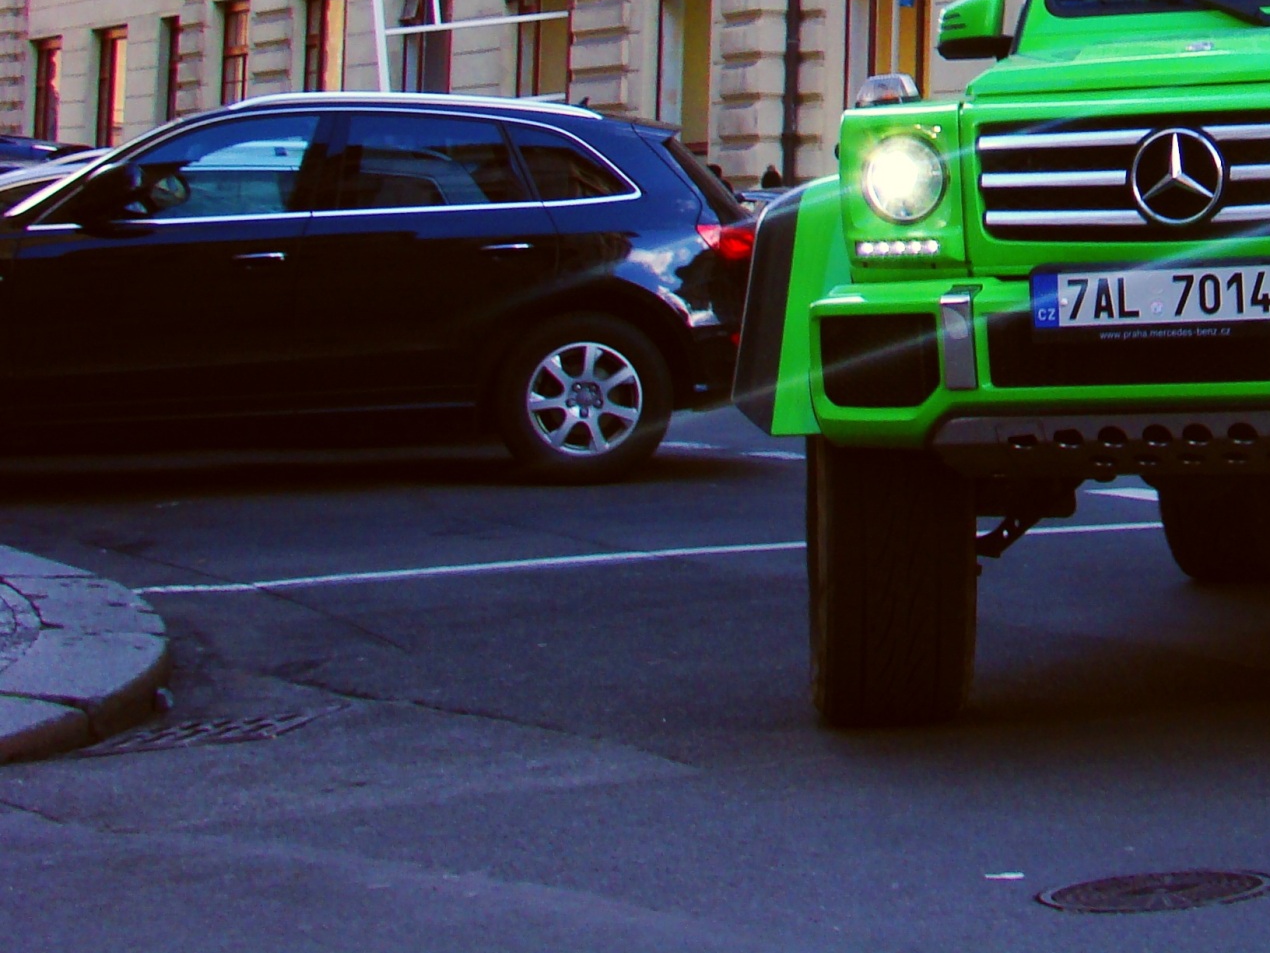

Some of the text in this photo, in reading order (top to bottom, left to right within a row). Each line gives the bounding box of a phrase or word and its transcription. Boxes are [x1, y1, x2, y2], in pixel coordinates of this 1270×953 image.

[1066, 277, 1140, 321] 7AL
[1038, 308, 1056, 321] CZ
[1099, 328, 1231, 340] www.praha.mercedes-benz.cz
